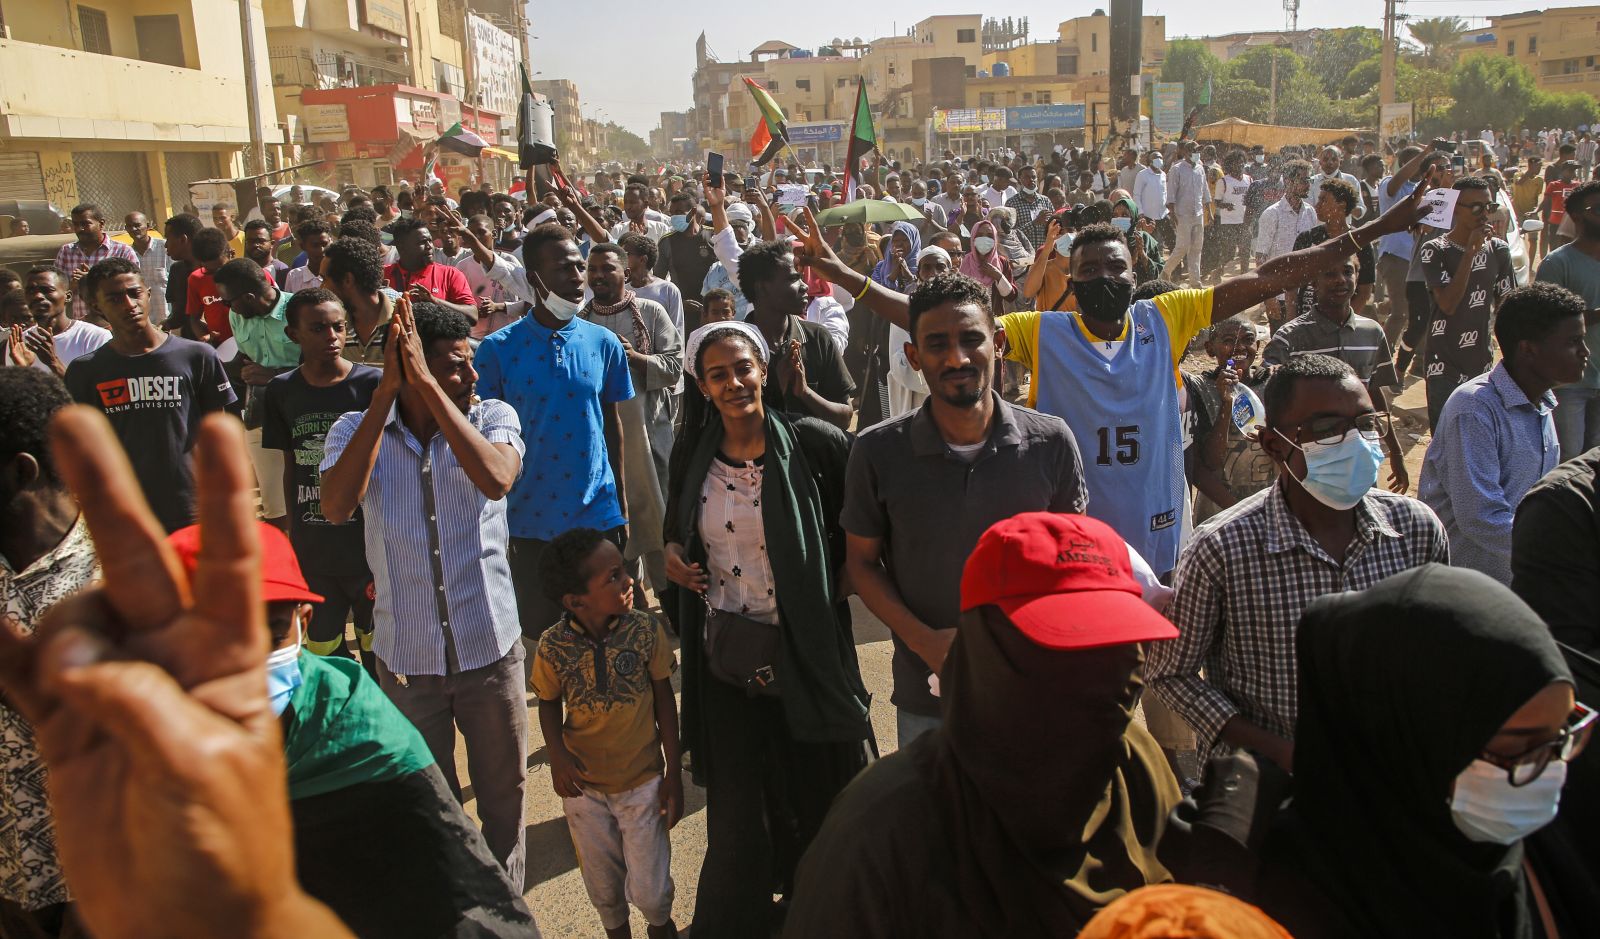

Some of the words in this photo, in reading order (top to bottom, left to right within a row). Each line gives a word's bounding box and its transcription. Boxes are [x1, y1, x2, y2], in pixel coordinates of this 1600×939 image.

[1471, 253, 1487, 269] 100
[1469, 290, 1486, 305] 100
[1431, 319, 1447, 333] 100
[1458, 330, 1478, 346] 100
[1427, 361, 1445, 378] 100
[127, 376, 182, 402] DIESEL
[134, 401, 182, 409] DIVISION
[292, 421, 320, 439] ASTERN
[1096, 425, 1140, 466] 15
[297, 484, 321, 505] ATLANT
